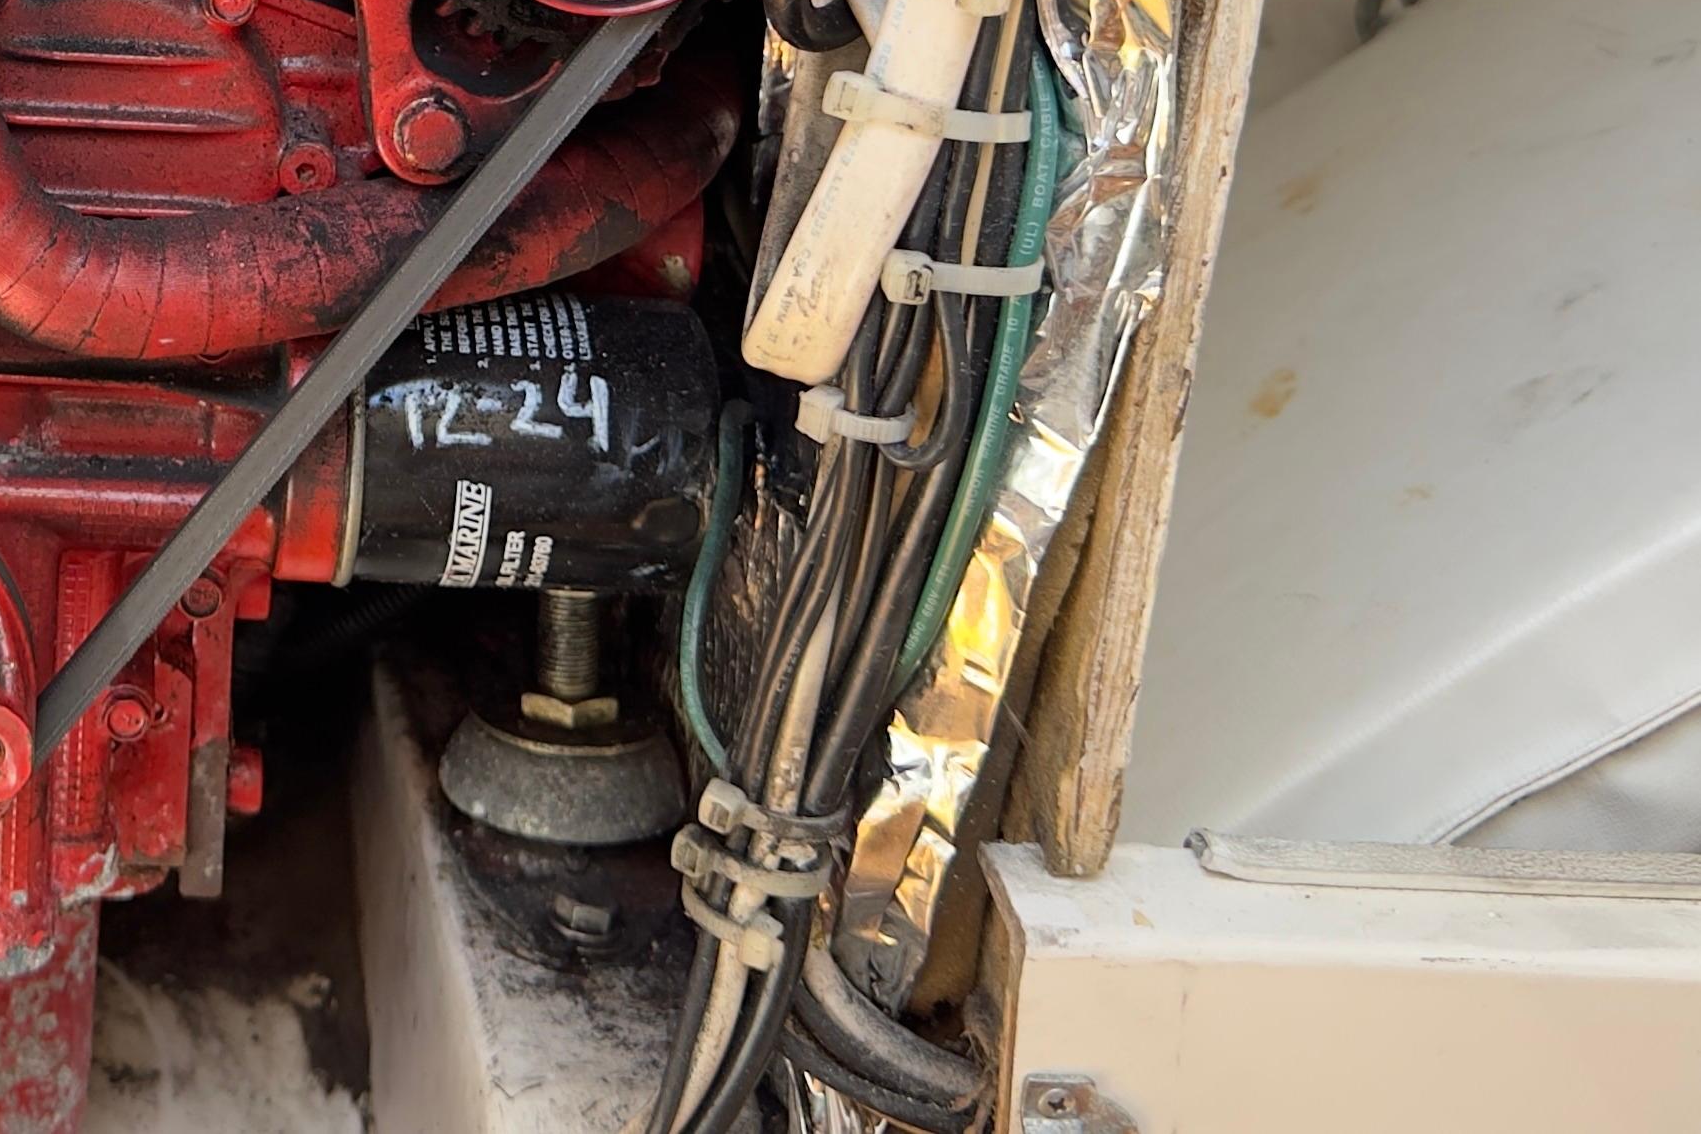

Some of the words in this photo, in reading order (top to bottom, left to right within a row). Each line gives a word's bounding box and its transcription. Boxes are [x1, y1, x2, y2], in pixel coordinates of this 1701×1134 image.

[1018, 221, 1040, 255] (UL)
[1032, 164, 1049, 209] BOAT
[423, 318, 436, 353] APPLY
[440, 330, 453, 353] THE
[456, 313, 471, 354] BEFORE
[474, 326, 488, 355] TURN
[491, 325, 505, 356] HAND
[507, 327, 523, 357] BASE
[524, 321, 540, 358] START
[541, 323, 557, 359] CHECK
[449, 479, 486, 574] MARINE
[499, 530, 526, 575] FILTER
